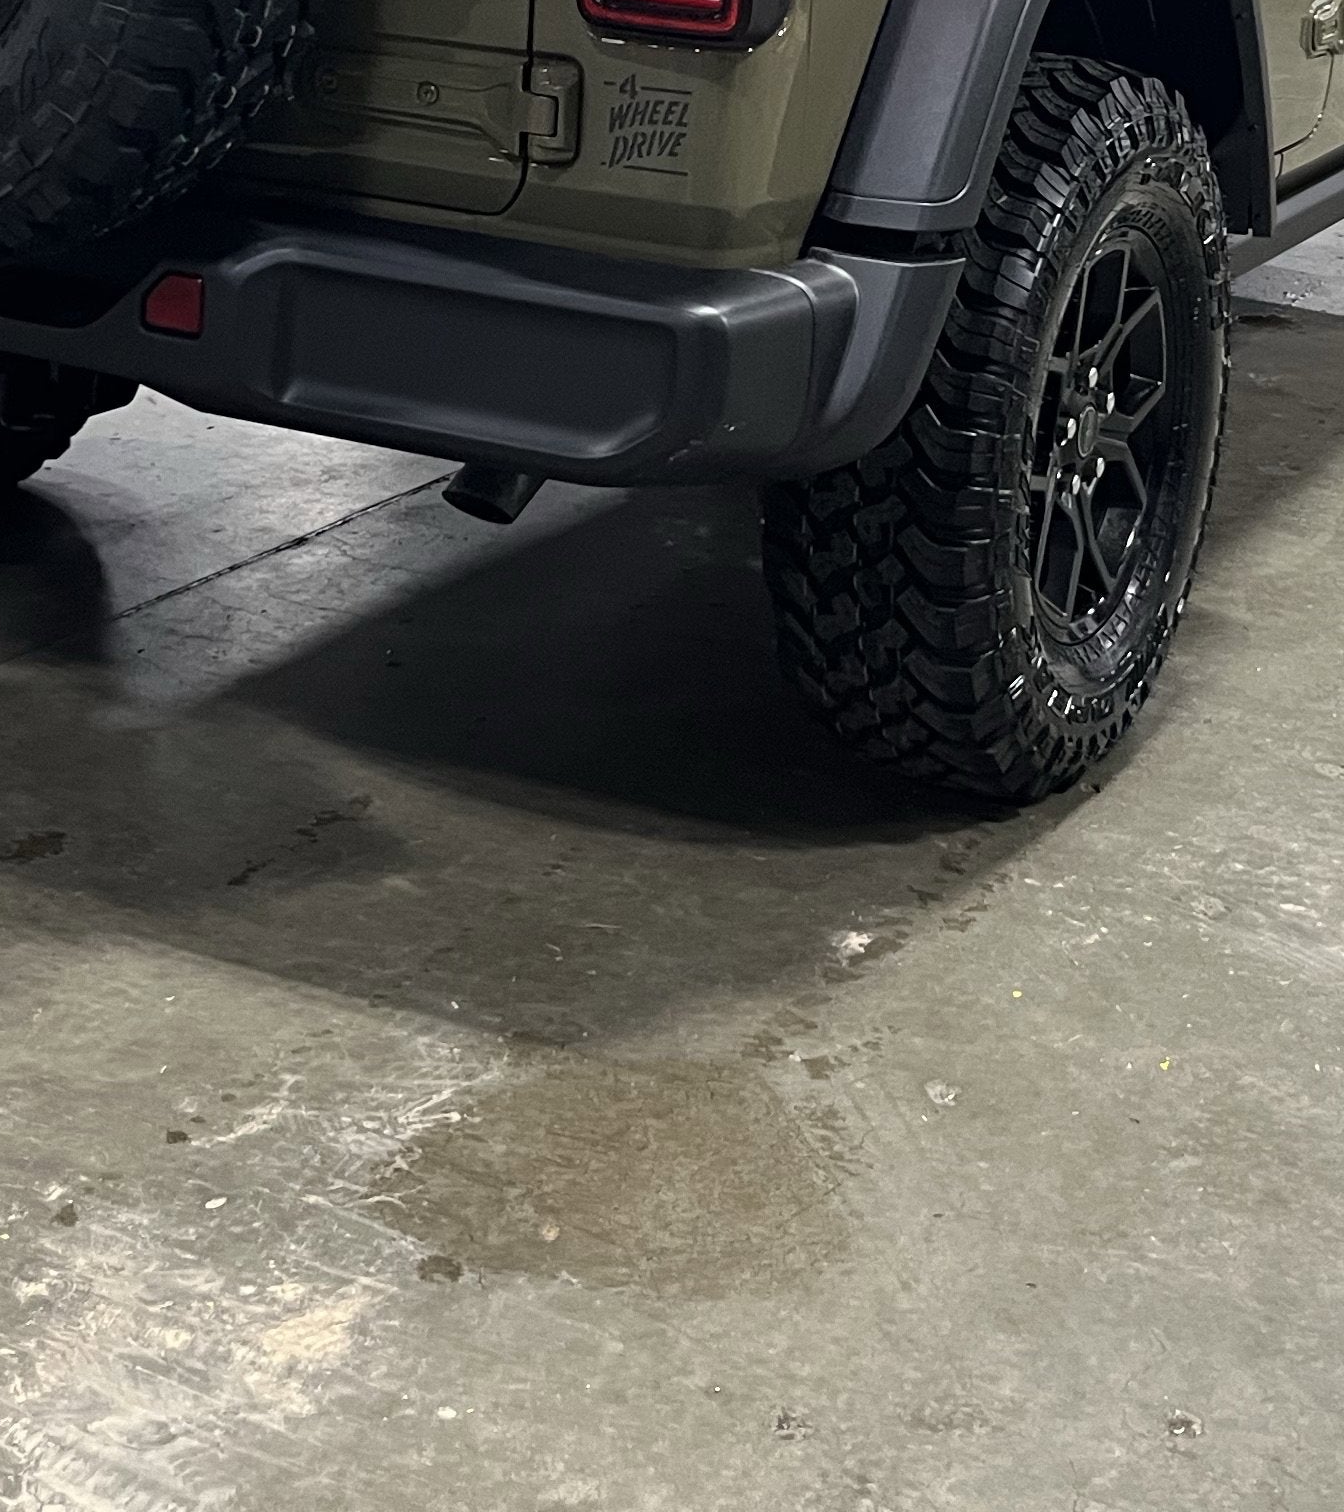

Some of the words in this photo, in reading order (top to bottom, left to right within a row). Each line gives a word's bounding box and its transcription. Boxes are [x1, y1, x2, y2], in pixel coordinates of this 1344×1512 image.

[619, 73, 638, 100] 4
[608, 99, 690, 134] WHEEL
[607, 130, 688, 169] DRIVE
